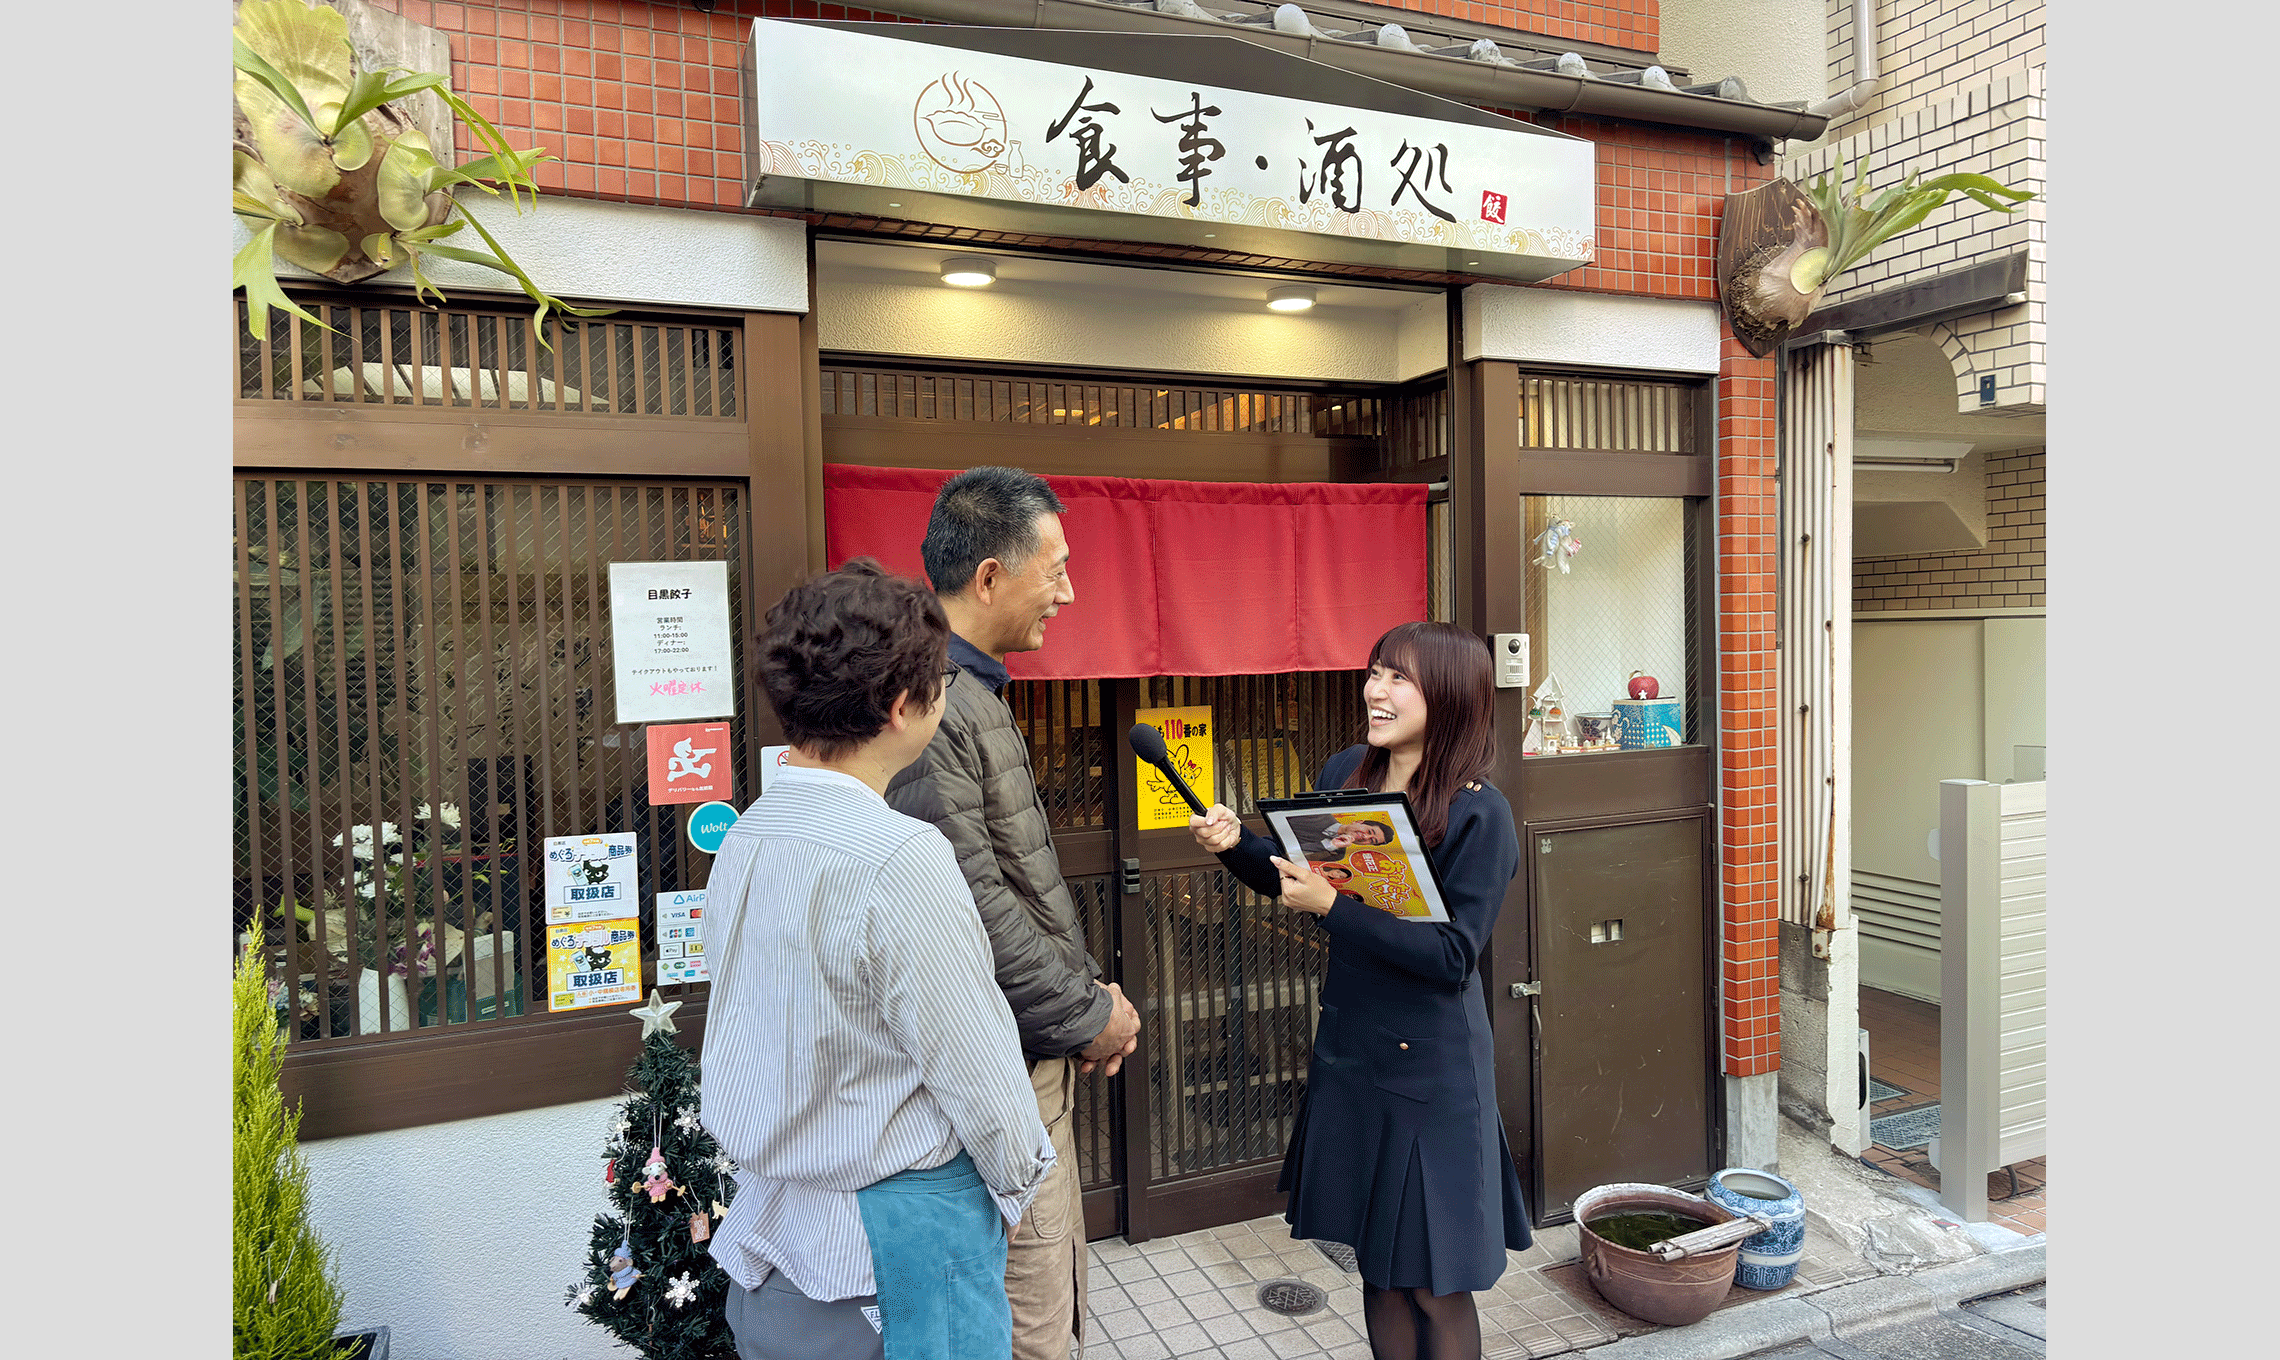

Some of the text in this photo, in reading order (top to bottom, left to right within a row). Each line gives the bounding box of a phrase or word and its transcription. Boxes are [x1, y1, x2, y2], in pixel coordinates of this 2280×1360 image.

[1046, 75, 1456, 223] 食事・酒処
[648, 588, 692, 600] 目黒餃子
[656, 616, 684, 624] 営業時間
[650, 679, 707, 697] 火曜定休
[701, 821, 729, 834] Wolt
[570, 885, 615, 901] 取扱店
[573, 971, 618, 987] 取扱店
